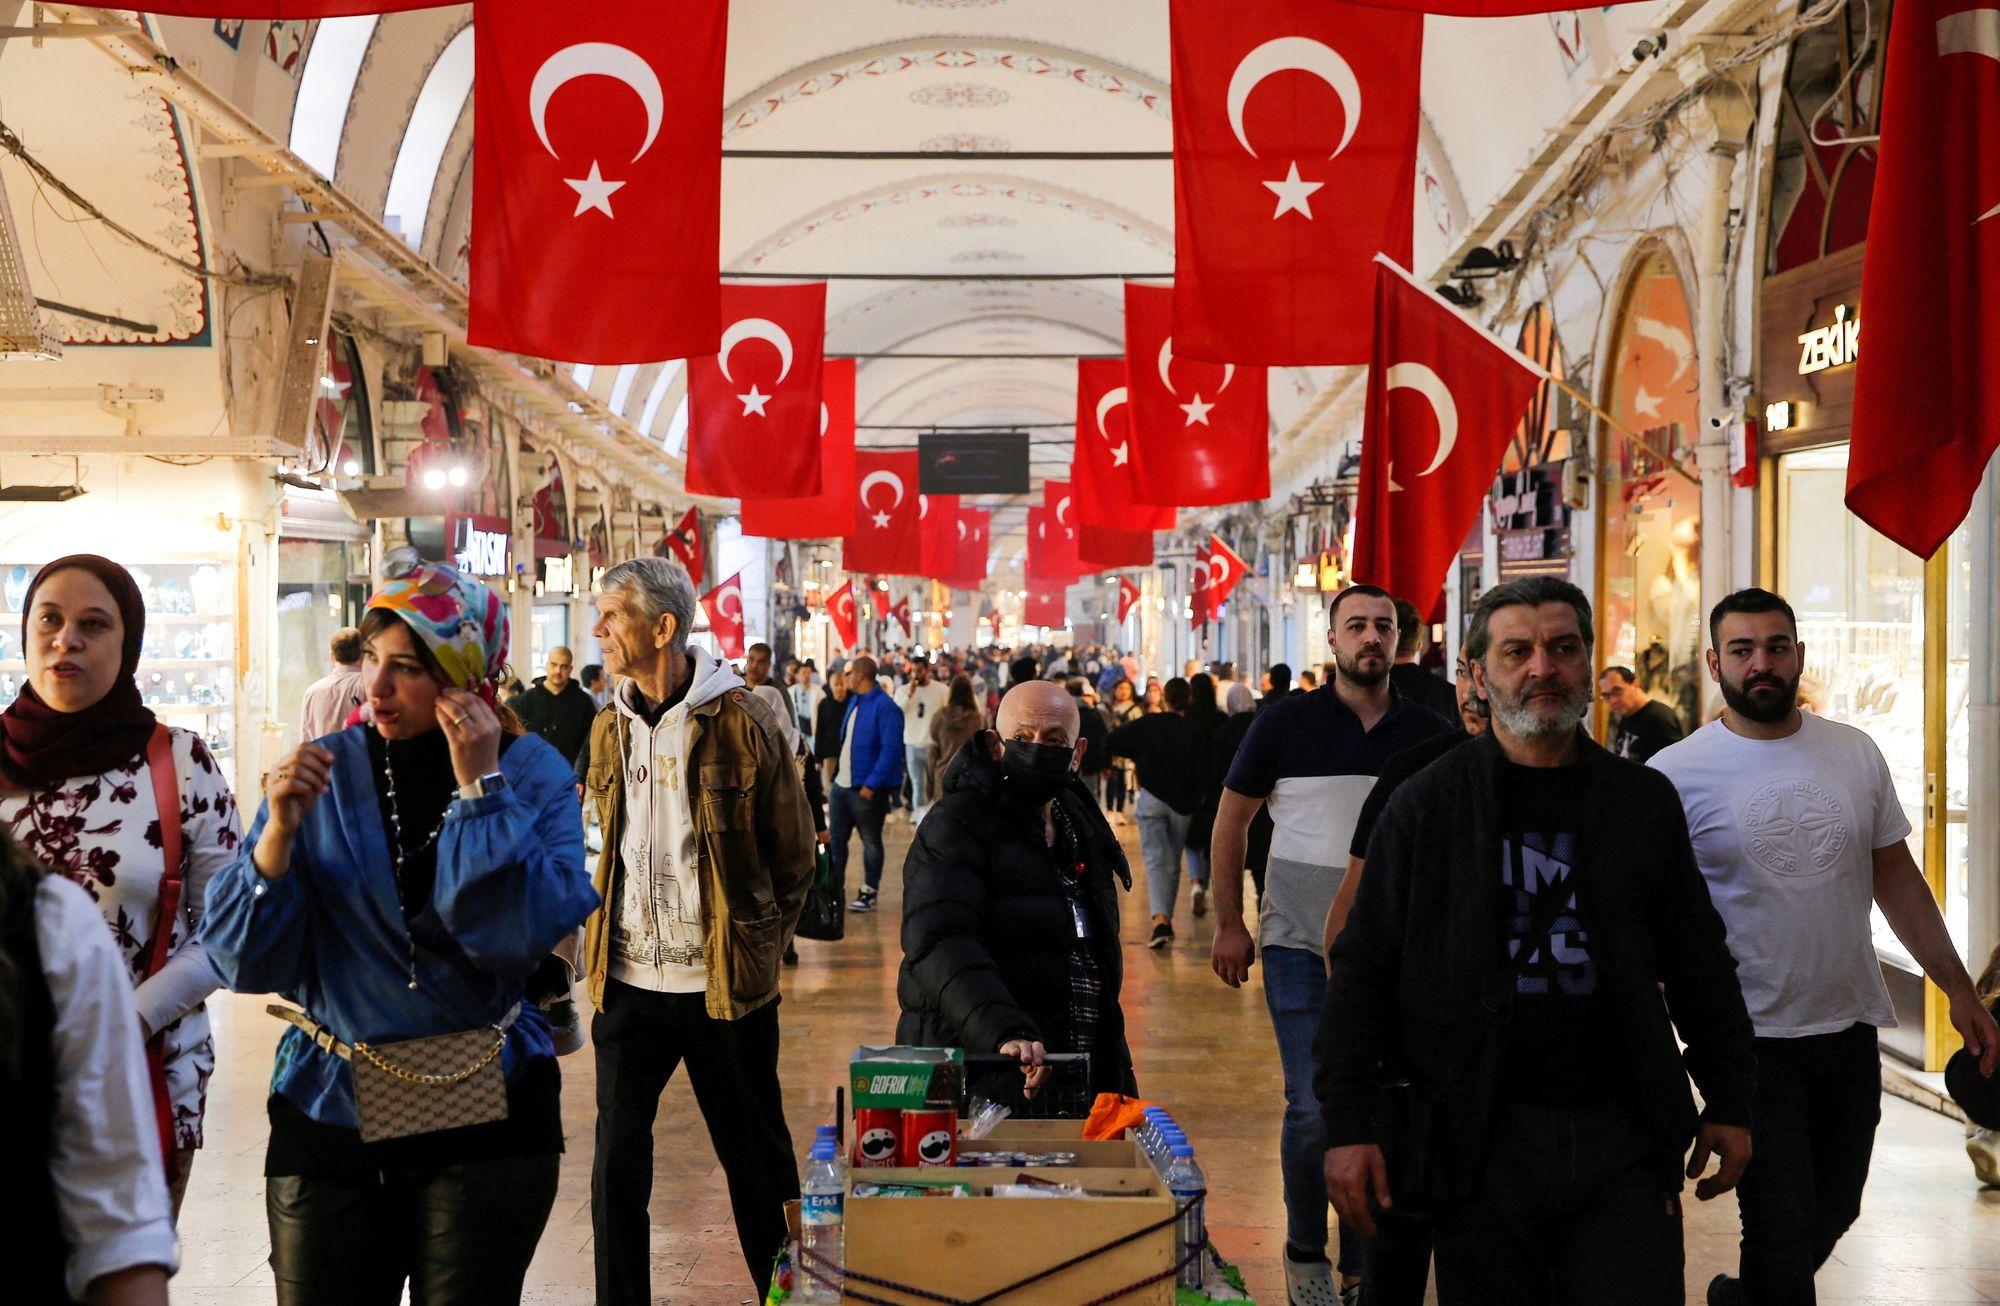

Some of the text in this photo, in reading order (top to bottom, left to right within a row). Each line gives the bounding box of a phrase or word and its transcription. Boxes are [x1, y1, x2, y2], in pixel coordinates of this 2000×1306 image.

[1744, 781, 1841, 828] STONE ISLAND
[870, 1075, 909, 1095] GOFRIK
